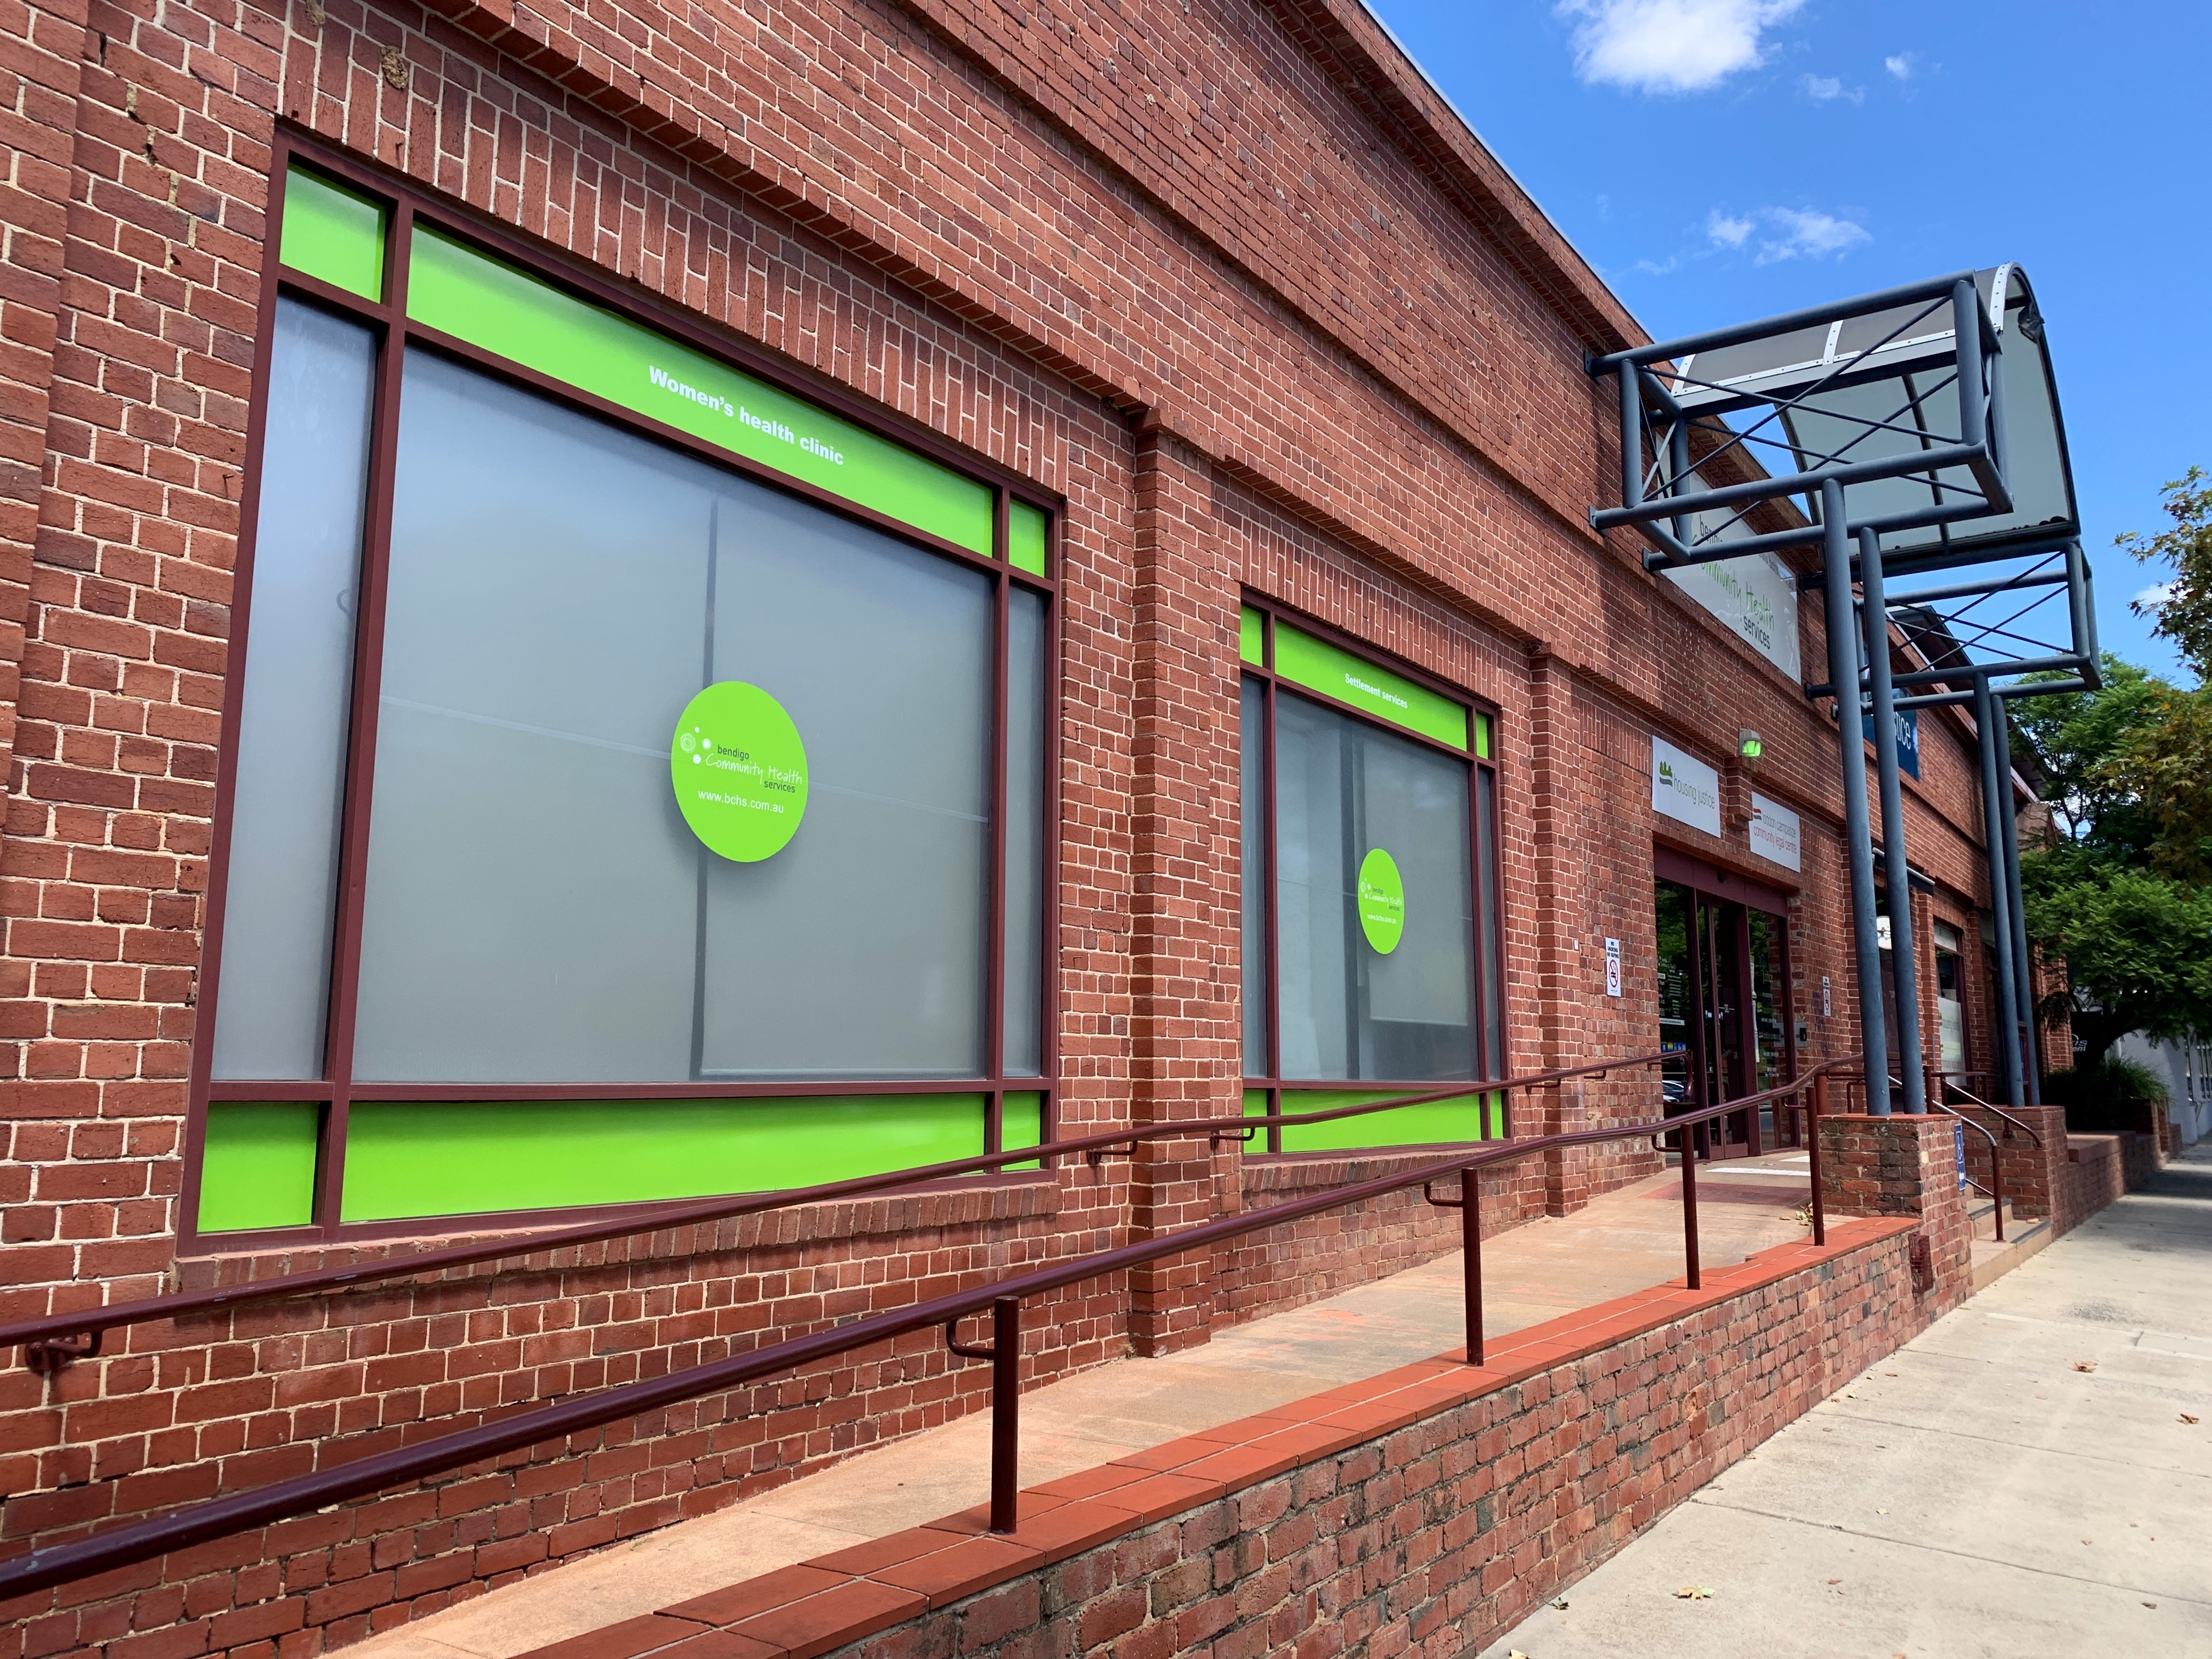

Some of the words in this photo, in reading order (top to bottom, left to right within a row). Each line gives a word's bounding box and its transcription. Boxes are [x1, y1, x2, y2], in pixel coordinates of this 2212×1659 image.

[740, 406, 794, 444] health
[800, 437, 844, 465] clinic
[1746, 581, 1774, 631] Health
[1744, 616, 1770, 650] services
[1345, 673, 1381, 697] Settlement
[1382, 691, 1408, 709] services
[706, 753, 763, 785] Community
[768, 765, 803, 785] Health
[717, 744, 749, 761] bendigo
[698, 790, 784, 814] www.bchs.com.au
[764, 780, 795, 793] services
[1674, 774, 1696, 805] housing
[1697, 786, 1715, 809] justice
[1753, 826, 1775, 847] community
